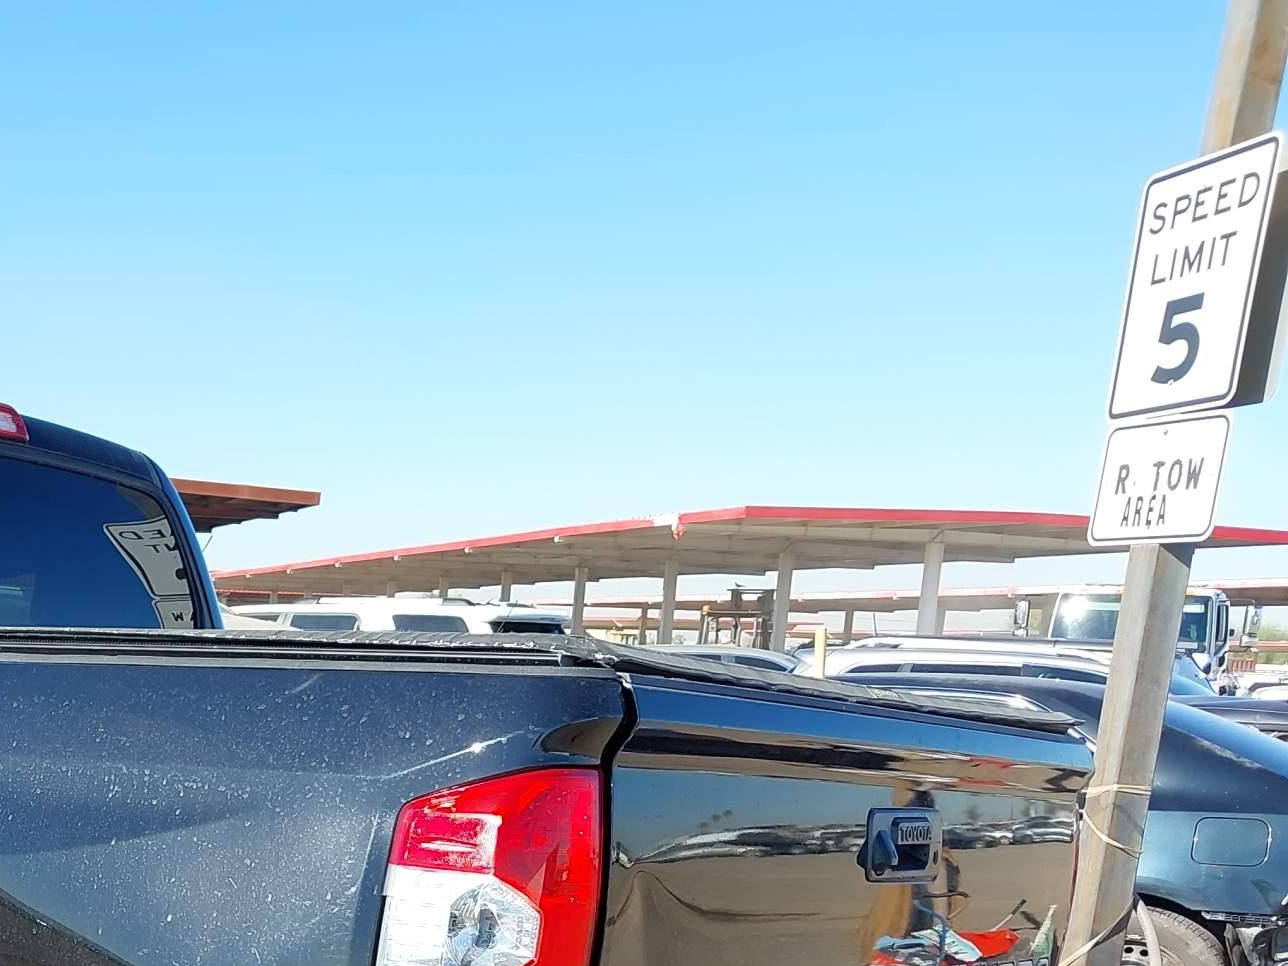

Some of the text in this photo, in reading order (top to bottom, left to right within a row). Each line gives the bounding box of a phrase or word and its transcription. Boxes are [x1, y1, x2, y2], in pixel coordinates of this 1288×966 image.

[1149, 172, 1260, 235] SPEED
[1150, 231, 1238, 286] LIMIT
[1150, 292, 1205, 384] 5
[1153, 457, 1205, 492] TOW
[1120, 494, 1166, 530] AREA
